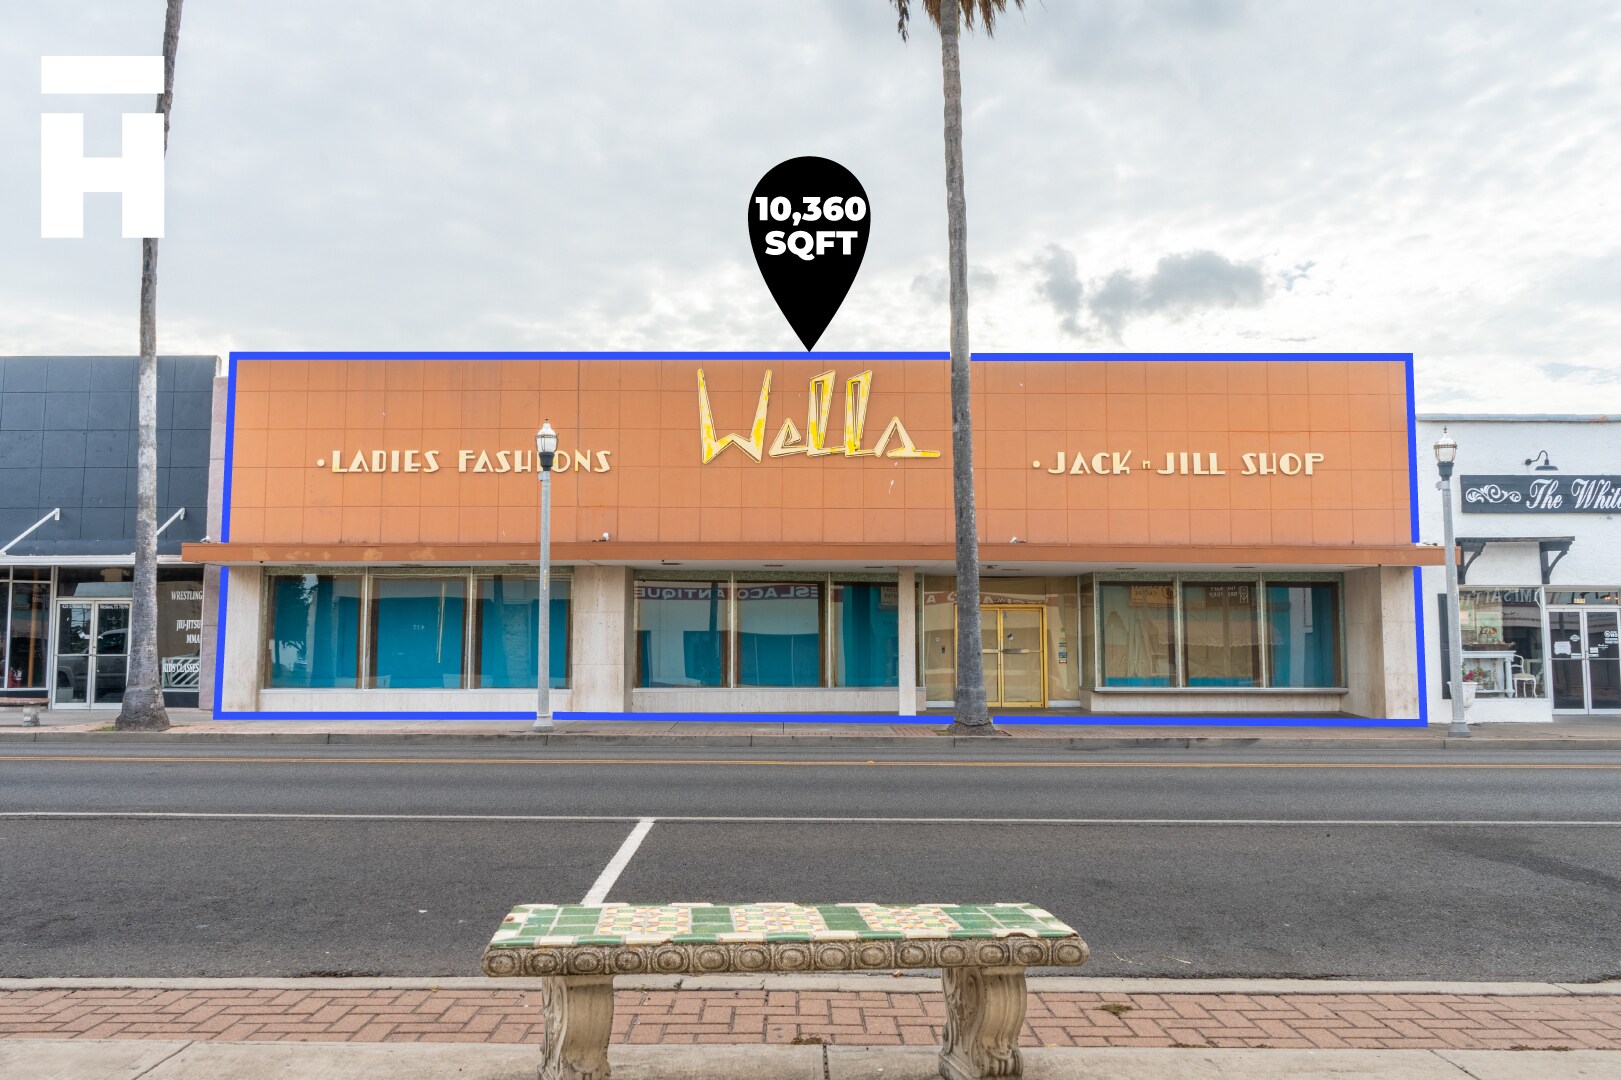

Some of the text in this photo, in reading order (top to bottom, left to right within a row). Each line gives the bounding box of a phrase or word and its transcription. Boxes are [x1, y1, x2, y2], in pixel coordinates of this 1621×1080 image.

[331, 449, 440, 474] LADIES
[1047, 449, 1132, 476] JACK
[1157, 452, 1226, 476] JILL
[1241, 452, 1325, 476] SHOP
[1526, 478, 1563, 509] The
[171, 590, 203, 601] WRESTLING
[176, 619, 202, 632] JIU-JITSU
[186, 634, 201, 644] MMA
